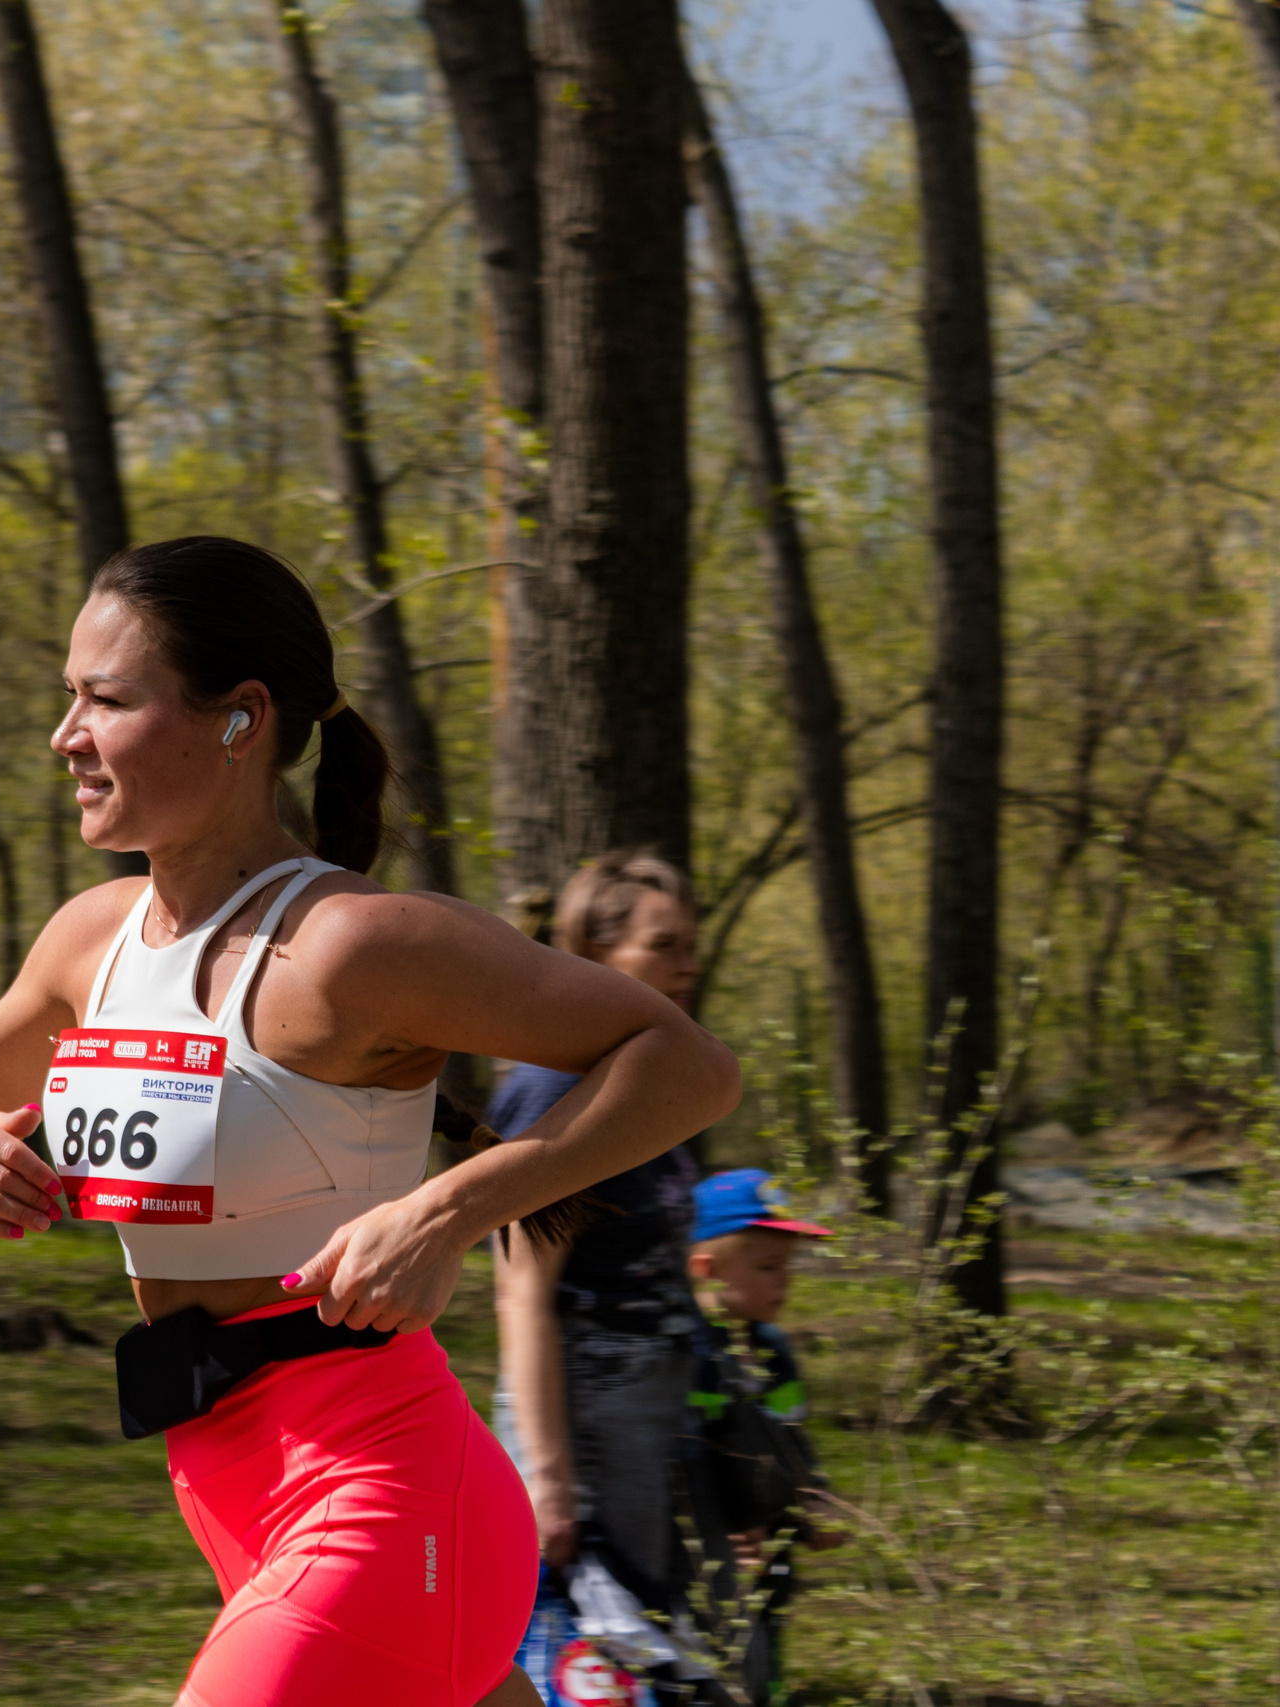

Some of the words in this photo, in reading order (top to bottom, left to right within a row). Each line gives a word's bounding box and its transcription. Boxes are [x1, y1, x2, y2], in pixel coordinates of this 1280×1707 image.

[79, 1037, 110, 1048] МАЙСКАЯ
[78, 1049, 97, 1058] ГРОЗА
[148, 1056, 175, 1064] HARPER
[142, 1078, 214, 1094] ВИКТОРИЯ
[181, 1095, 212, 1103] строим
[63, 1107, 160, 1171] 866
[142, 1198, 201, 1212] BERGAUER
[424, 1535, 437, 1593] ROWAN
